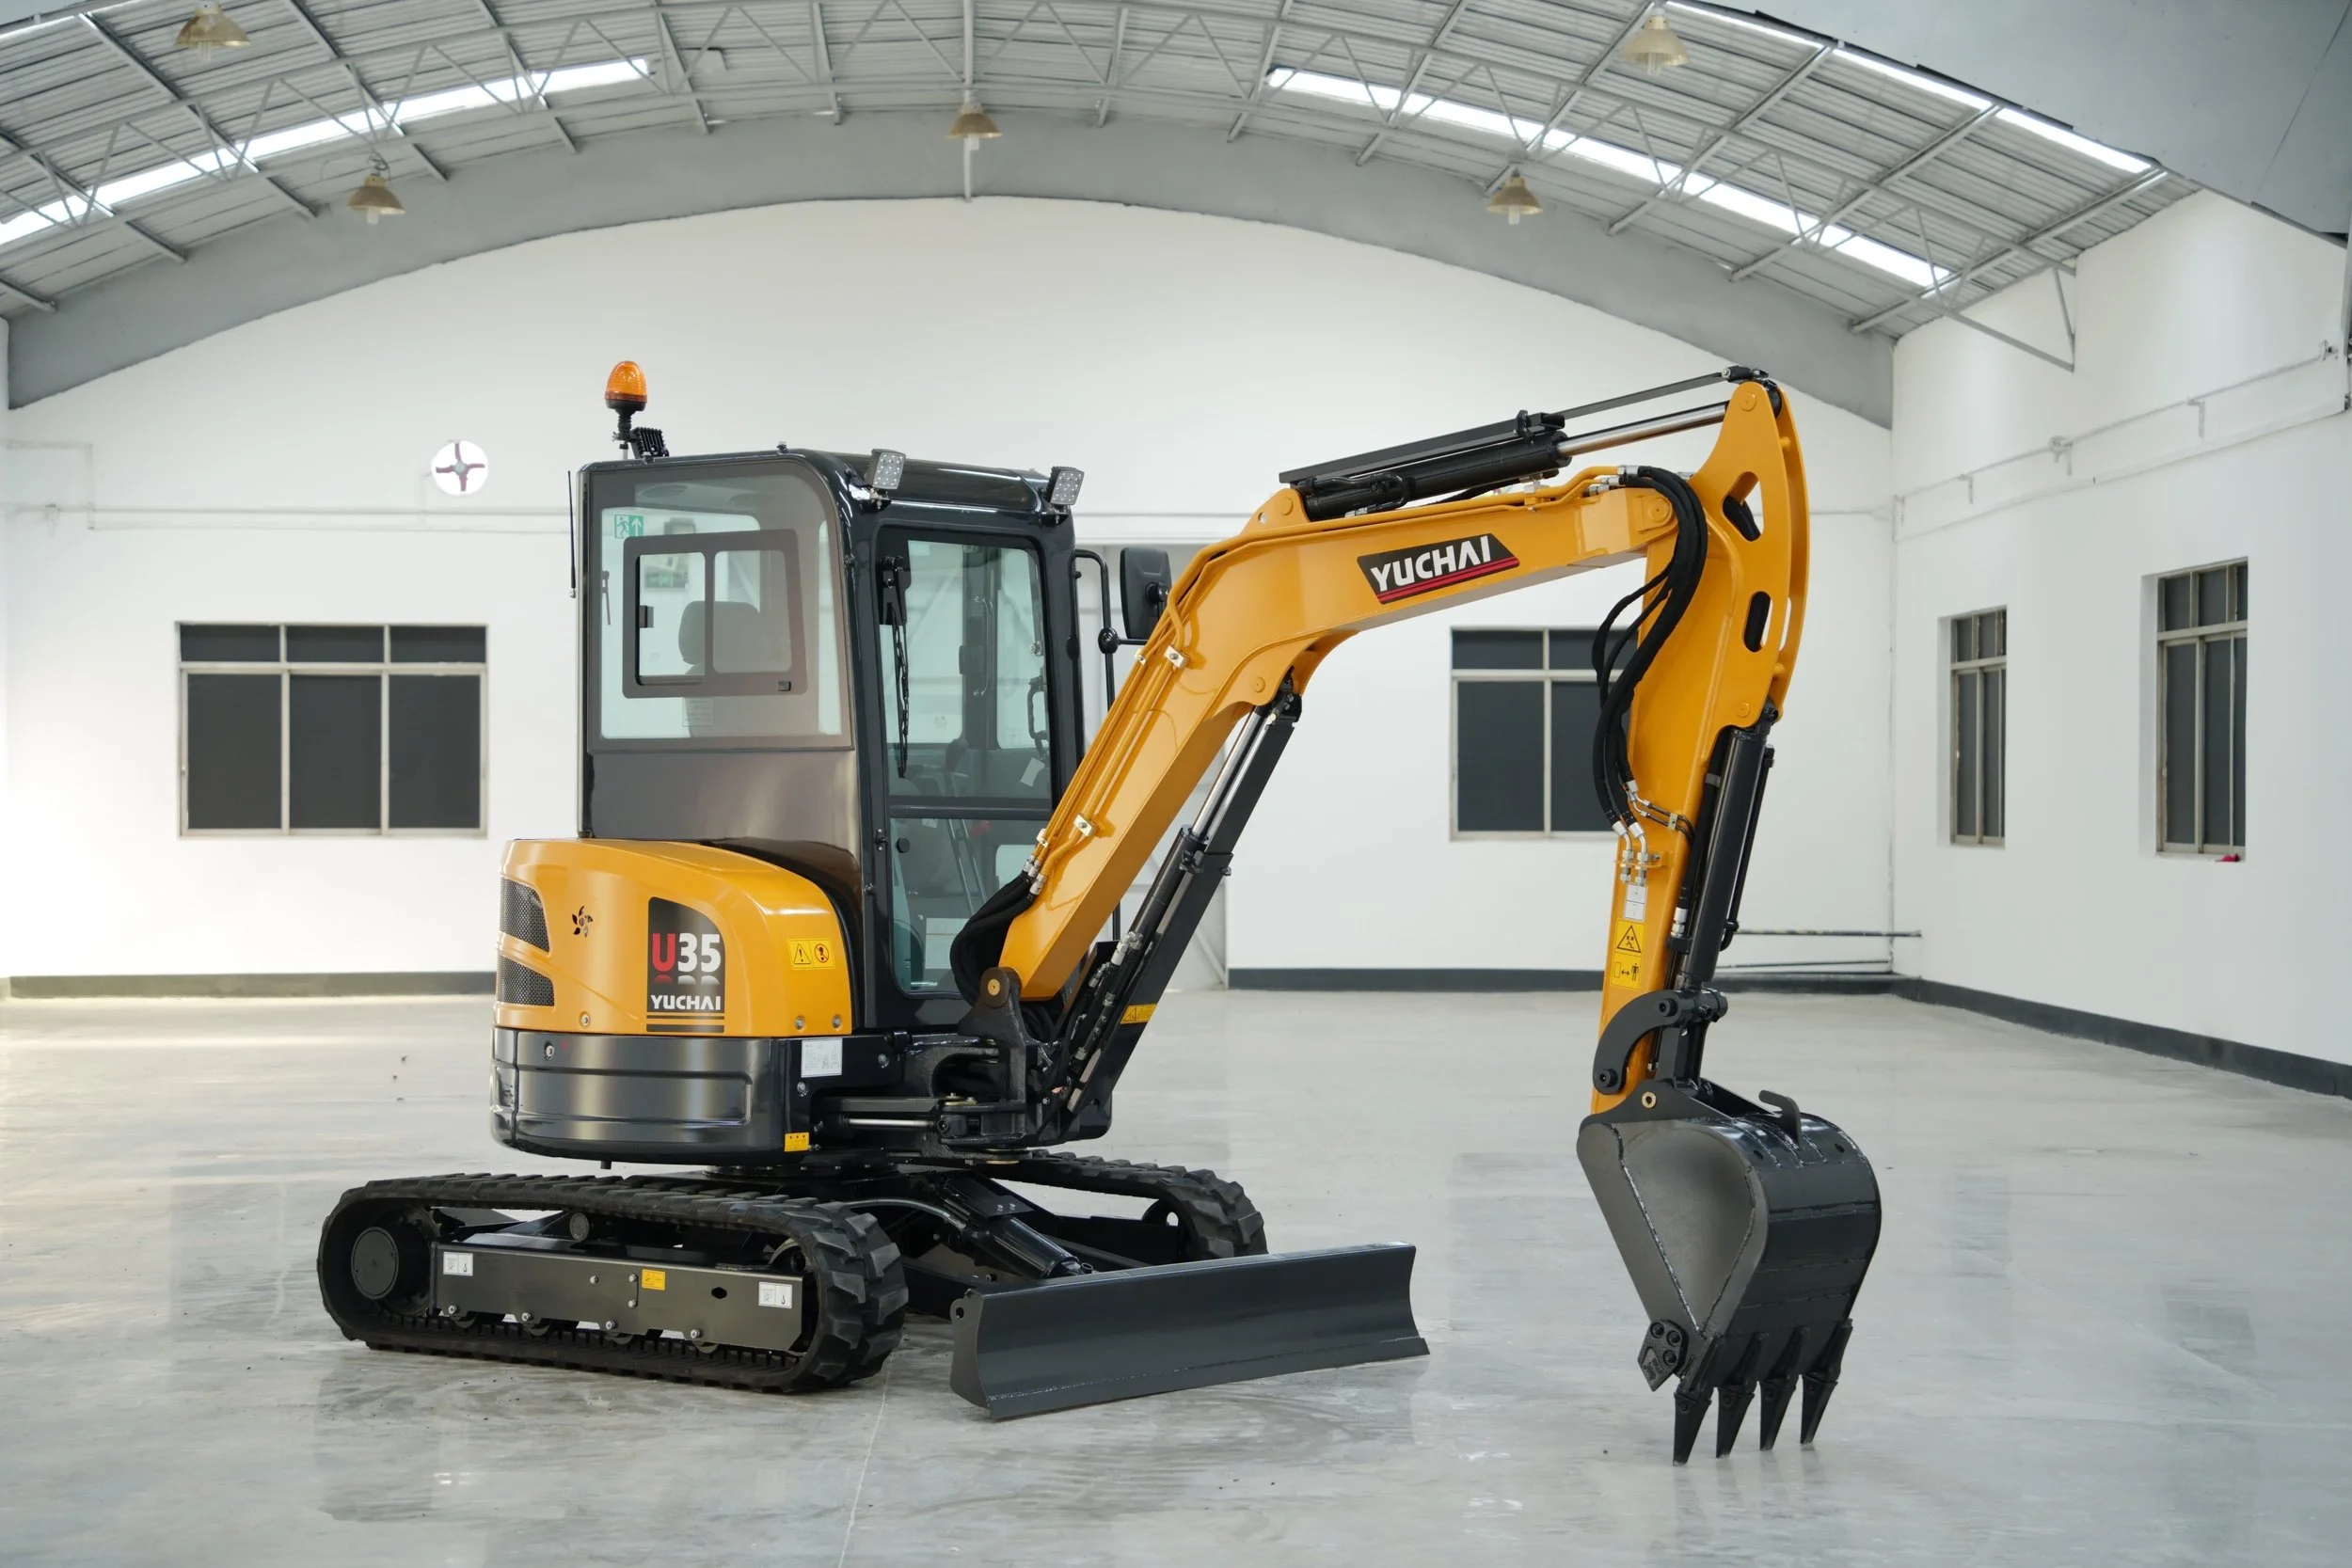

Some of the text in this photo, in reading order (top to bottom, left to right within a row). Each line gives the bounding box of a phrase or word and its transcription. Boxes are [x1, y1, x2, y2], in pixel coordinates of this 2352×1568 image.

[1370, 535, 1491, 592] YUCHAI
[652, 932, 722, 973] U35
[650, 994, 722, 1011] YUCHAI
